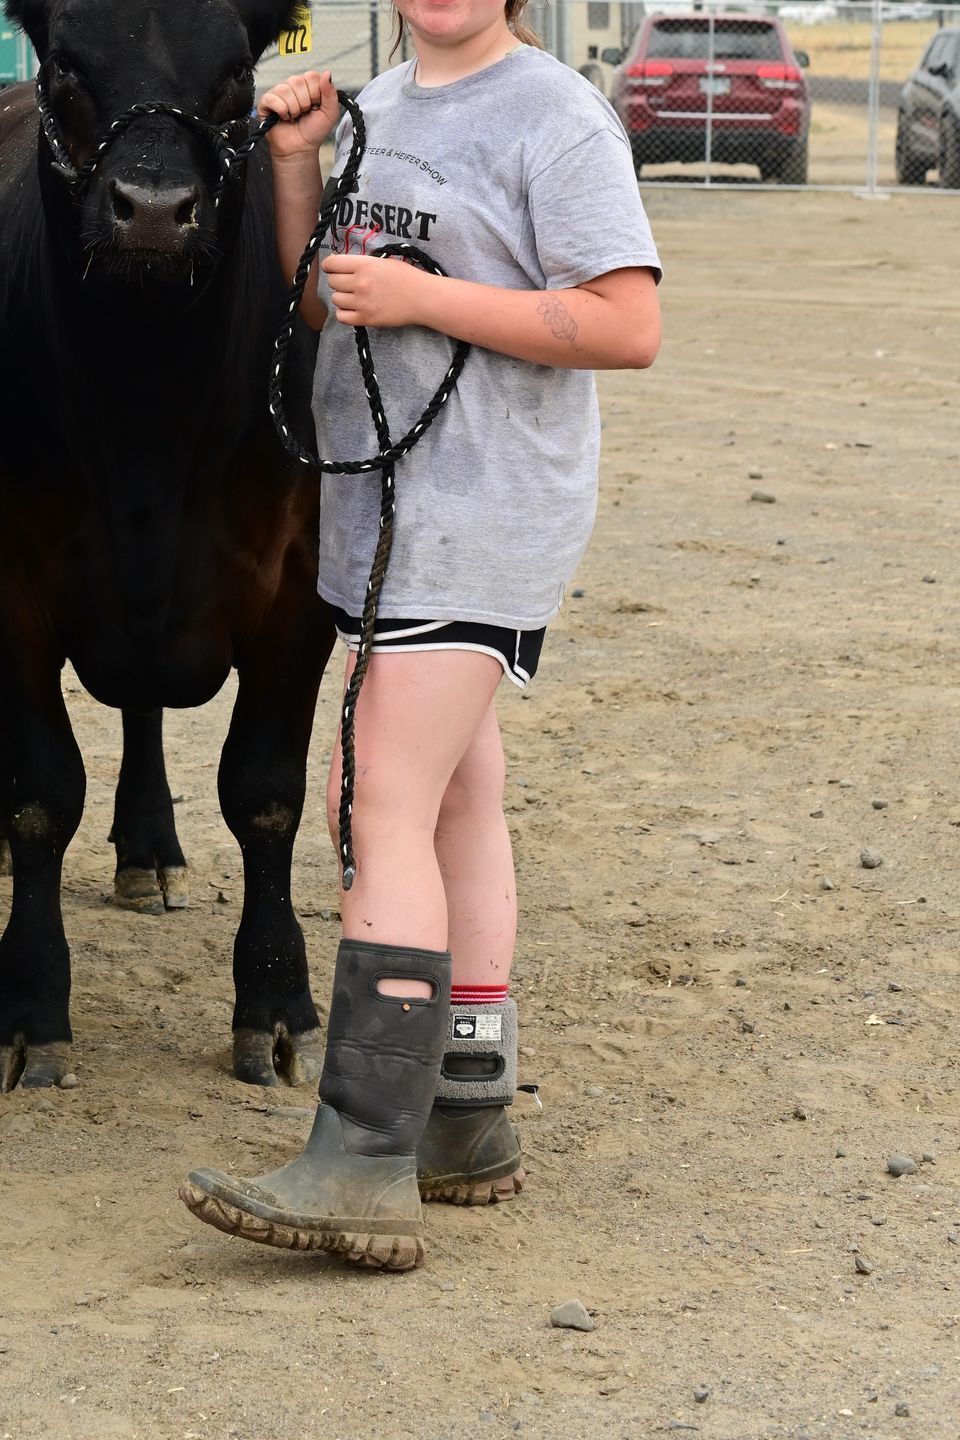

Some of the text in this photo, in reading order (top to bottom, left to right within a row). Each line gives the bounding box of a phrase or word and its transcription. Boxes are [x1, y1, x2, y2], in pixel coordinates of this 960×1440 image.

[386, 148, 394, 157] &
[394, 150, 421, 166] HEIFER
[419, 161, 448, 186] SHOW
[337, 197, 437, 242] DESERT
